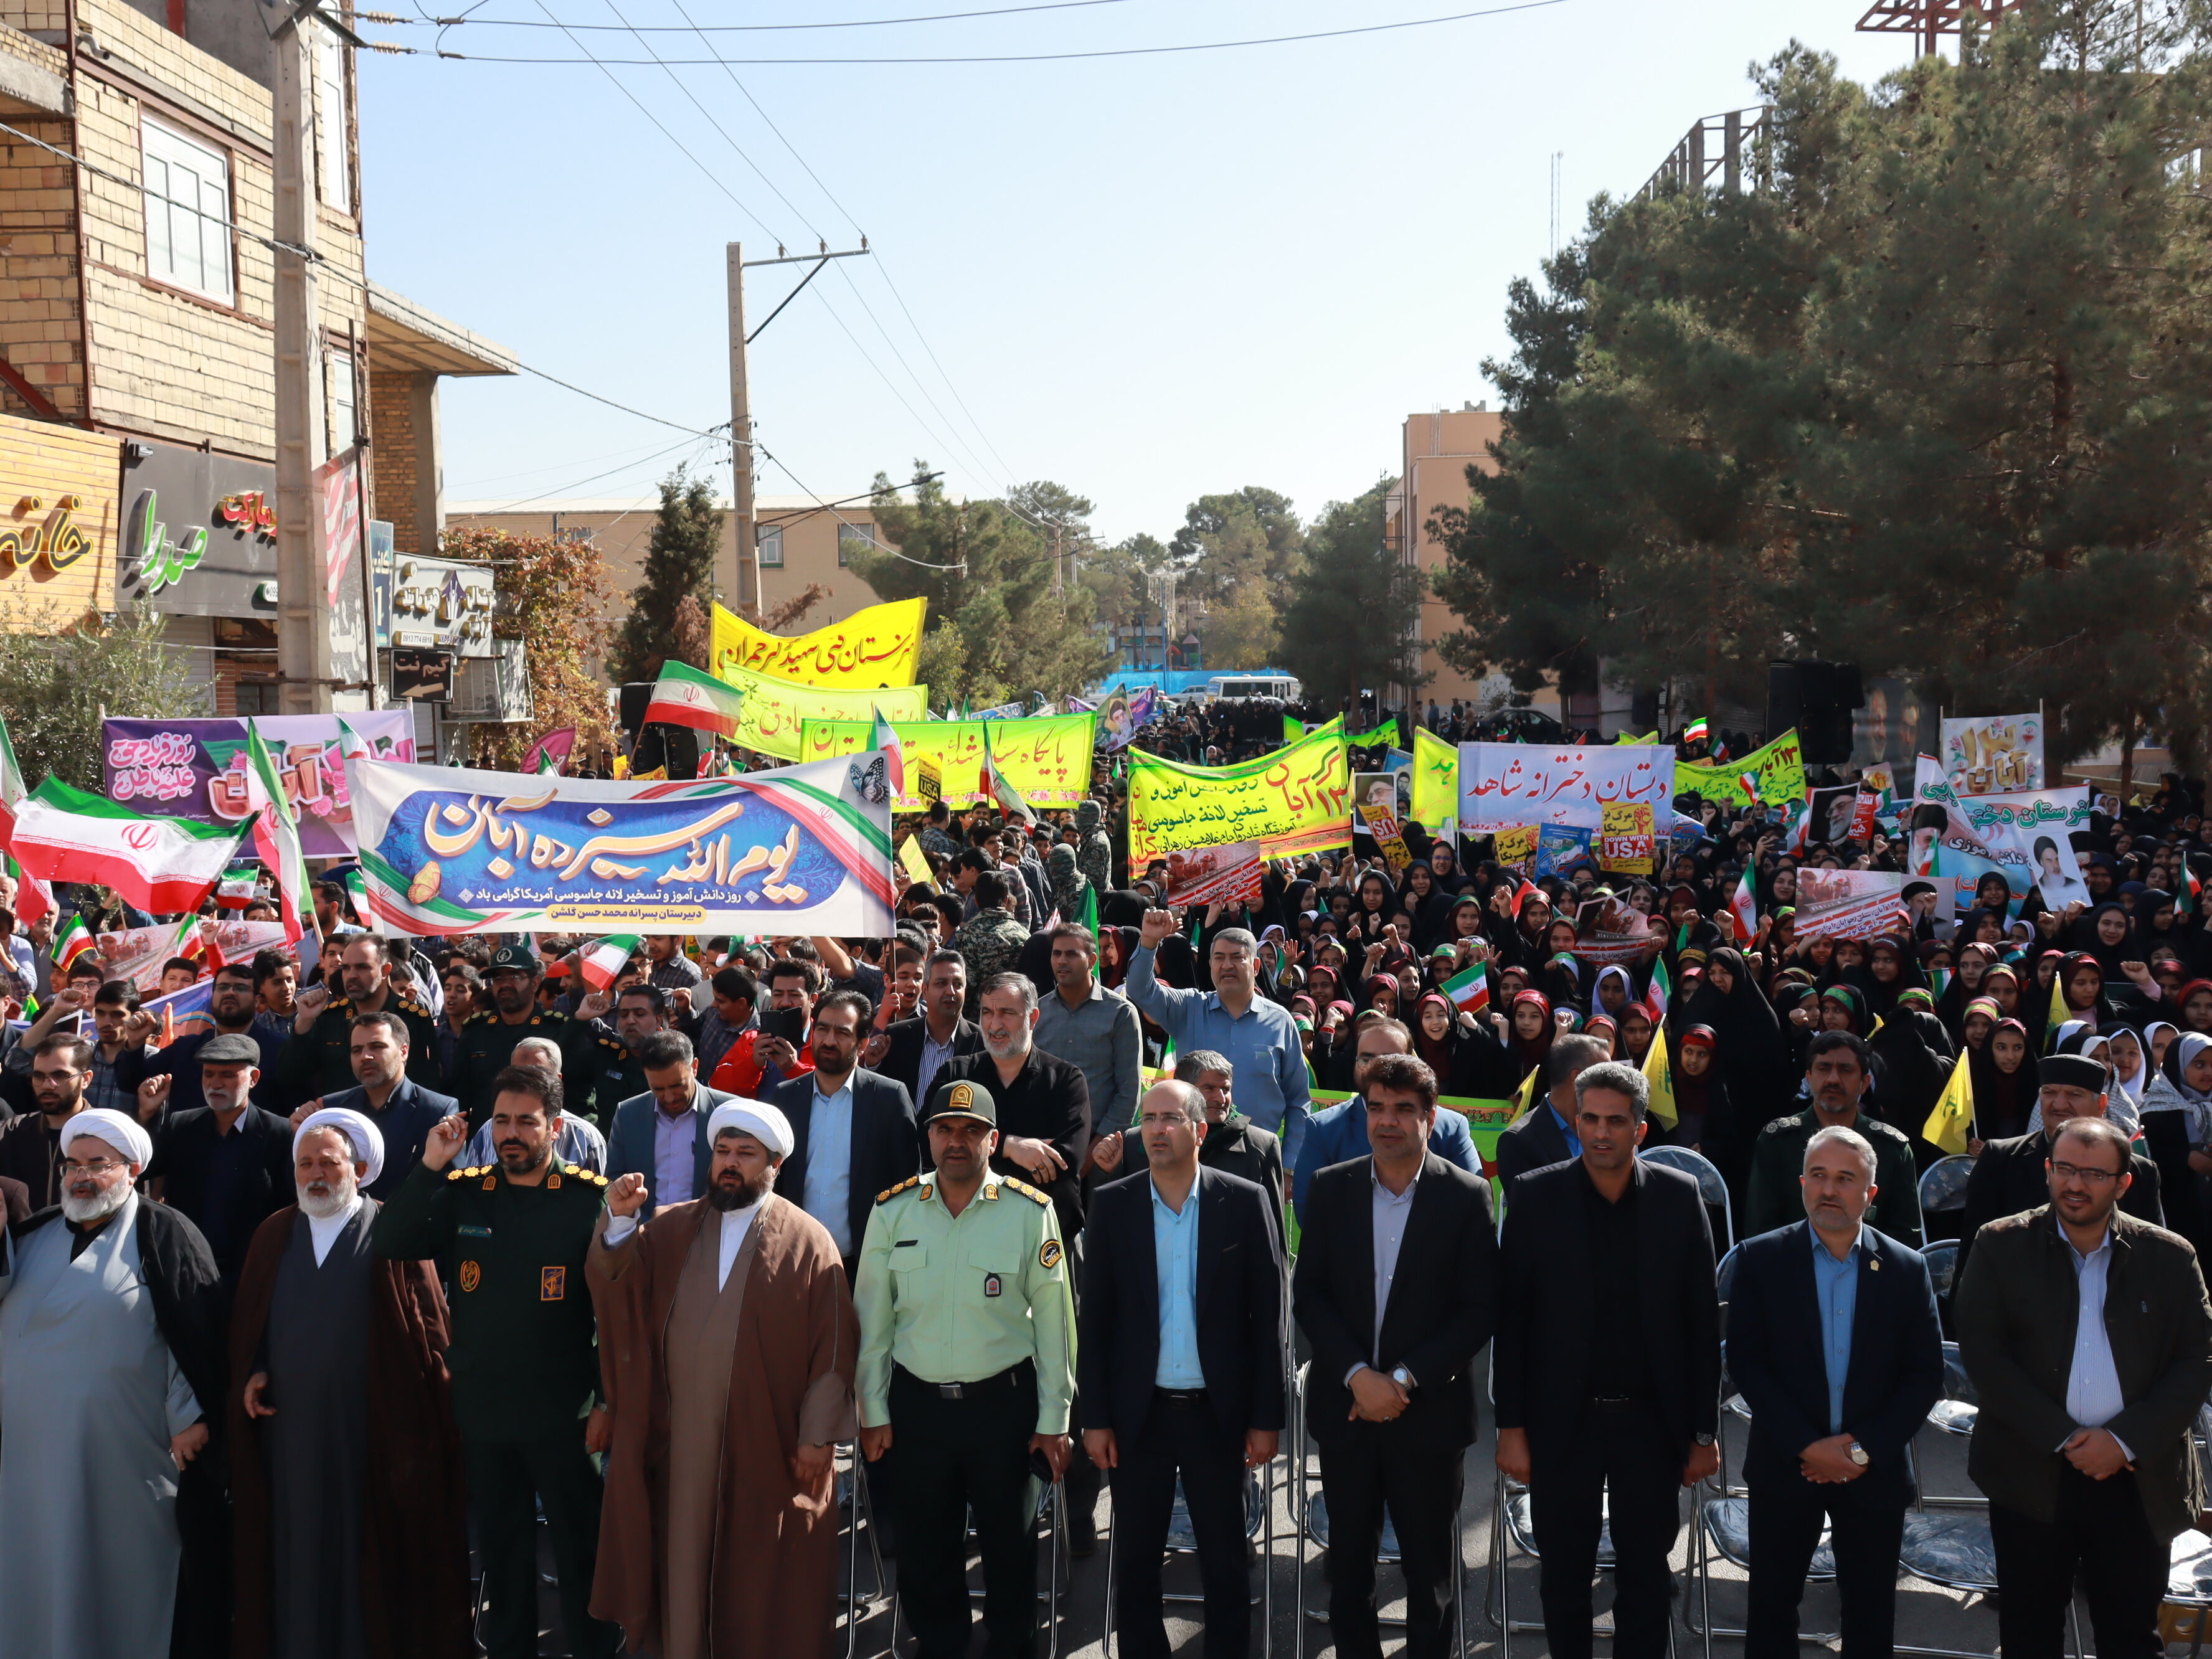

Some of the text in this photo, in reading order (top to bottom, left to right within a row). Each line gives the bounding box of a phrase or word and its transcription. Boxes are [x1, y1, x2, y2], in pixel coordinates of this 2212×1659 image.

[141, 489, 207, 592] صدرا
[395, 655, 450, 678] گیم نت
[759, 701, 801, 735] ادق
[1020, 724, 1068, 783] پایگاه
[1960, 724, 2017, 769] ۱۳
[1465, 758, 1524, 798] شاهد
[1525, 753, 1591, 805] دخترانه
[1595, 762, 1667, 805] دبستان
[1967, 749, 2029, 794] آبان
[920, 778, 939, 802] USA
[1150, 788, 1159, 801] و
[1160, 778, 1188, 800] آموز
[1148, 808, 1196, 833] جاسوسی
[1228, 798, 1269, 825] تسخیر
[1602, 810, 1632, 823] مرگ بر
[1604, 820, 1637, 836] آمریکا
[423, 787, 807, 904] یوم الله سیزده آبان
[1498, 837, 1525, 851] مرگ بر
[1604, 840, 1647, 858] USA
[476, 887, 742, 903] روز دانش آموز و تسخیر لانه جاسوسی آمریکا گرامی باد
[551, 907, 702, 922] دبیرستان پسرانه محمد حسن گلشن
